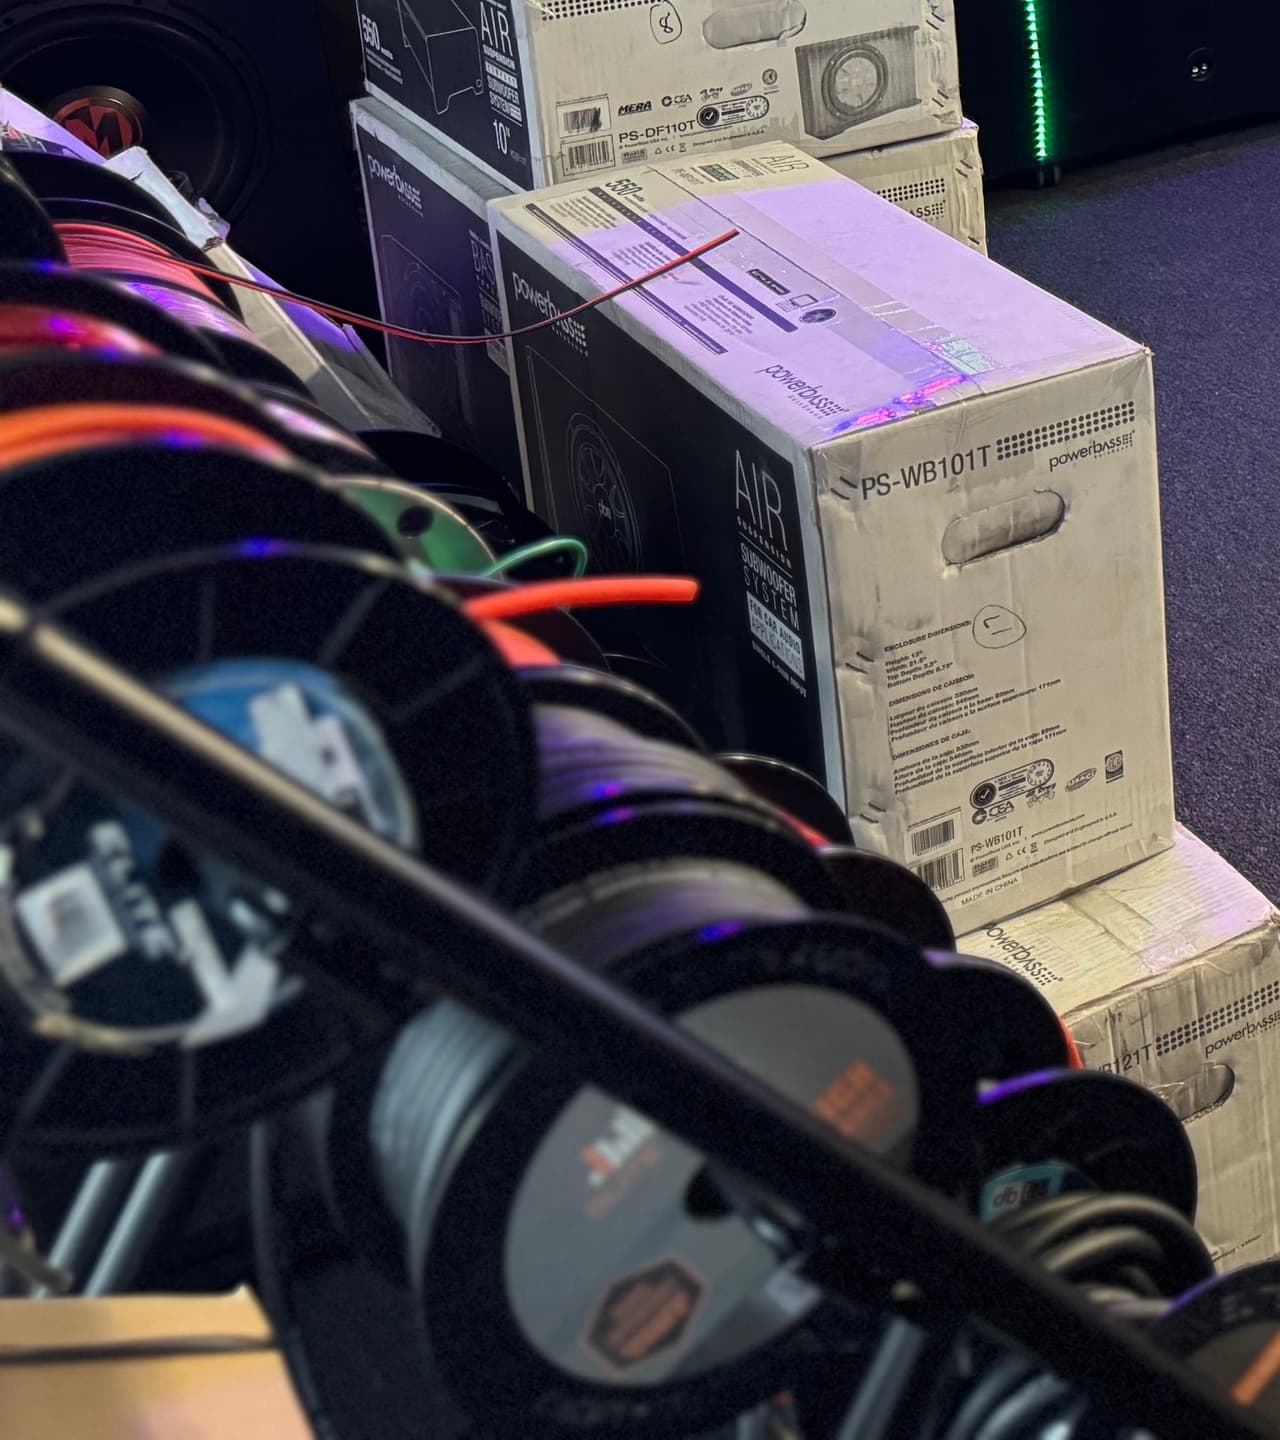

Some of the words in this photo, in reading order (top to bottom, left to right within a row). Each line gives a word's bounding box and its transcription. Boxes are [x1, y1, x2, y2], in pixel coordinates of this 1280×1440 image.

[480, 1, 514, 57] AIR
[618, 119, 696, 143] PS-DF110T
[862, 443, 992, 500] PS-WB101T
[1049, 433, 1128, 472] powerbass
[735, 449, 788, 551] AIR
[740, 541, 797, 603] SUBWOOFER
[744, 566, 800, 631] SYSTEM
[884, 633, 926, 653] ENCLOSURE
[970, 825, 1024, 855] PS-WB101T
[961, 892, 980, 905] MADE
[994, 877, 1019, 891] CHINA
[1204, 1009, 1279, 1059] powerbass
